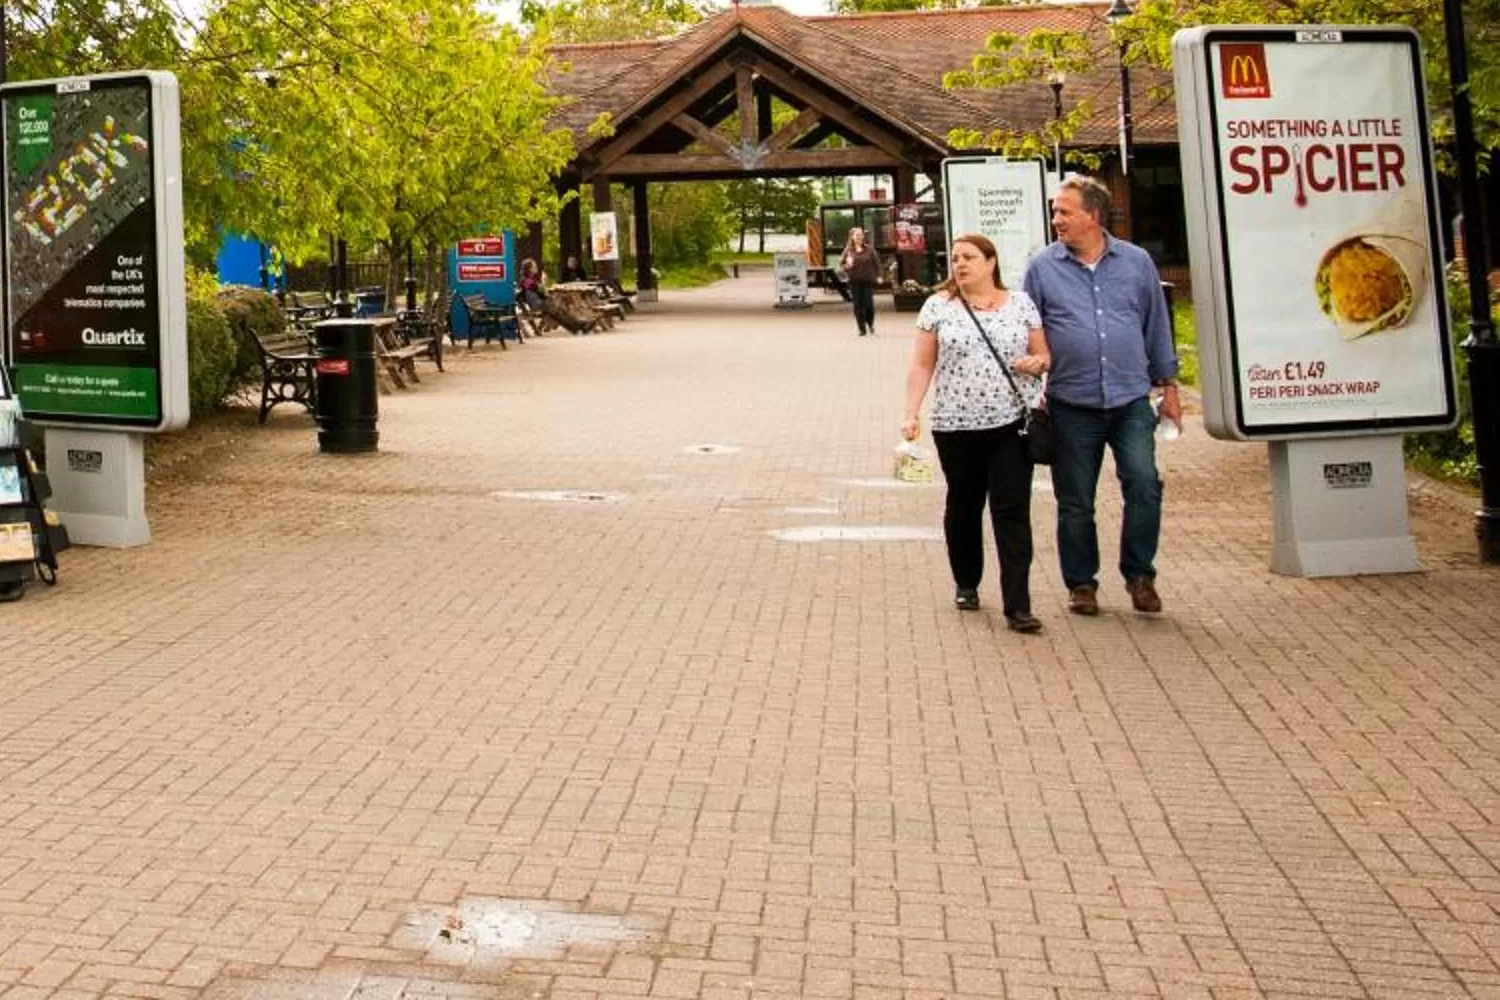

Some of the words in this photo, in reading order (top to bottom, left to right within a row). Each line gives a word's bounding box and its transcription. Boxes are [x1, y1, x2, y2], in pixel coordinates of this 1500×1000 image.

[1227, 119, 1328, 139] SOMETHING
[1331, 120, 1344, 137] A
[1347, 119, 1402, 137] LITTLE
[1229, 142, 1406, 207] SPICIER
[117, 255, 134, 267] One
[111, 269, 124, 280] the
[81, 327, 146, 345] Quartix
[1284, 360, 1326, 381] £1.49
[1249, 385, 1277, 399] PERI
[1279, 383, 1305, 398] PERI
[1307, 382, 1343, 397] SNACK
[1345, 380, 1381, 394] WRAP
